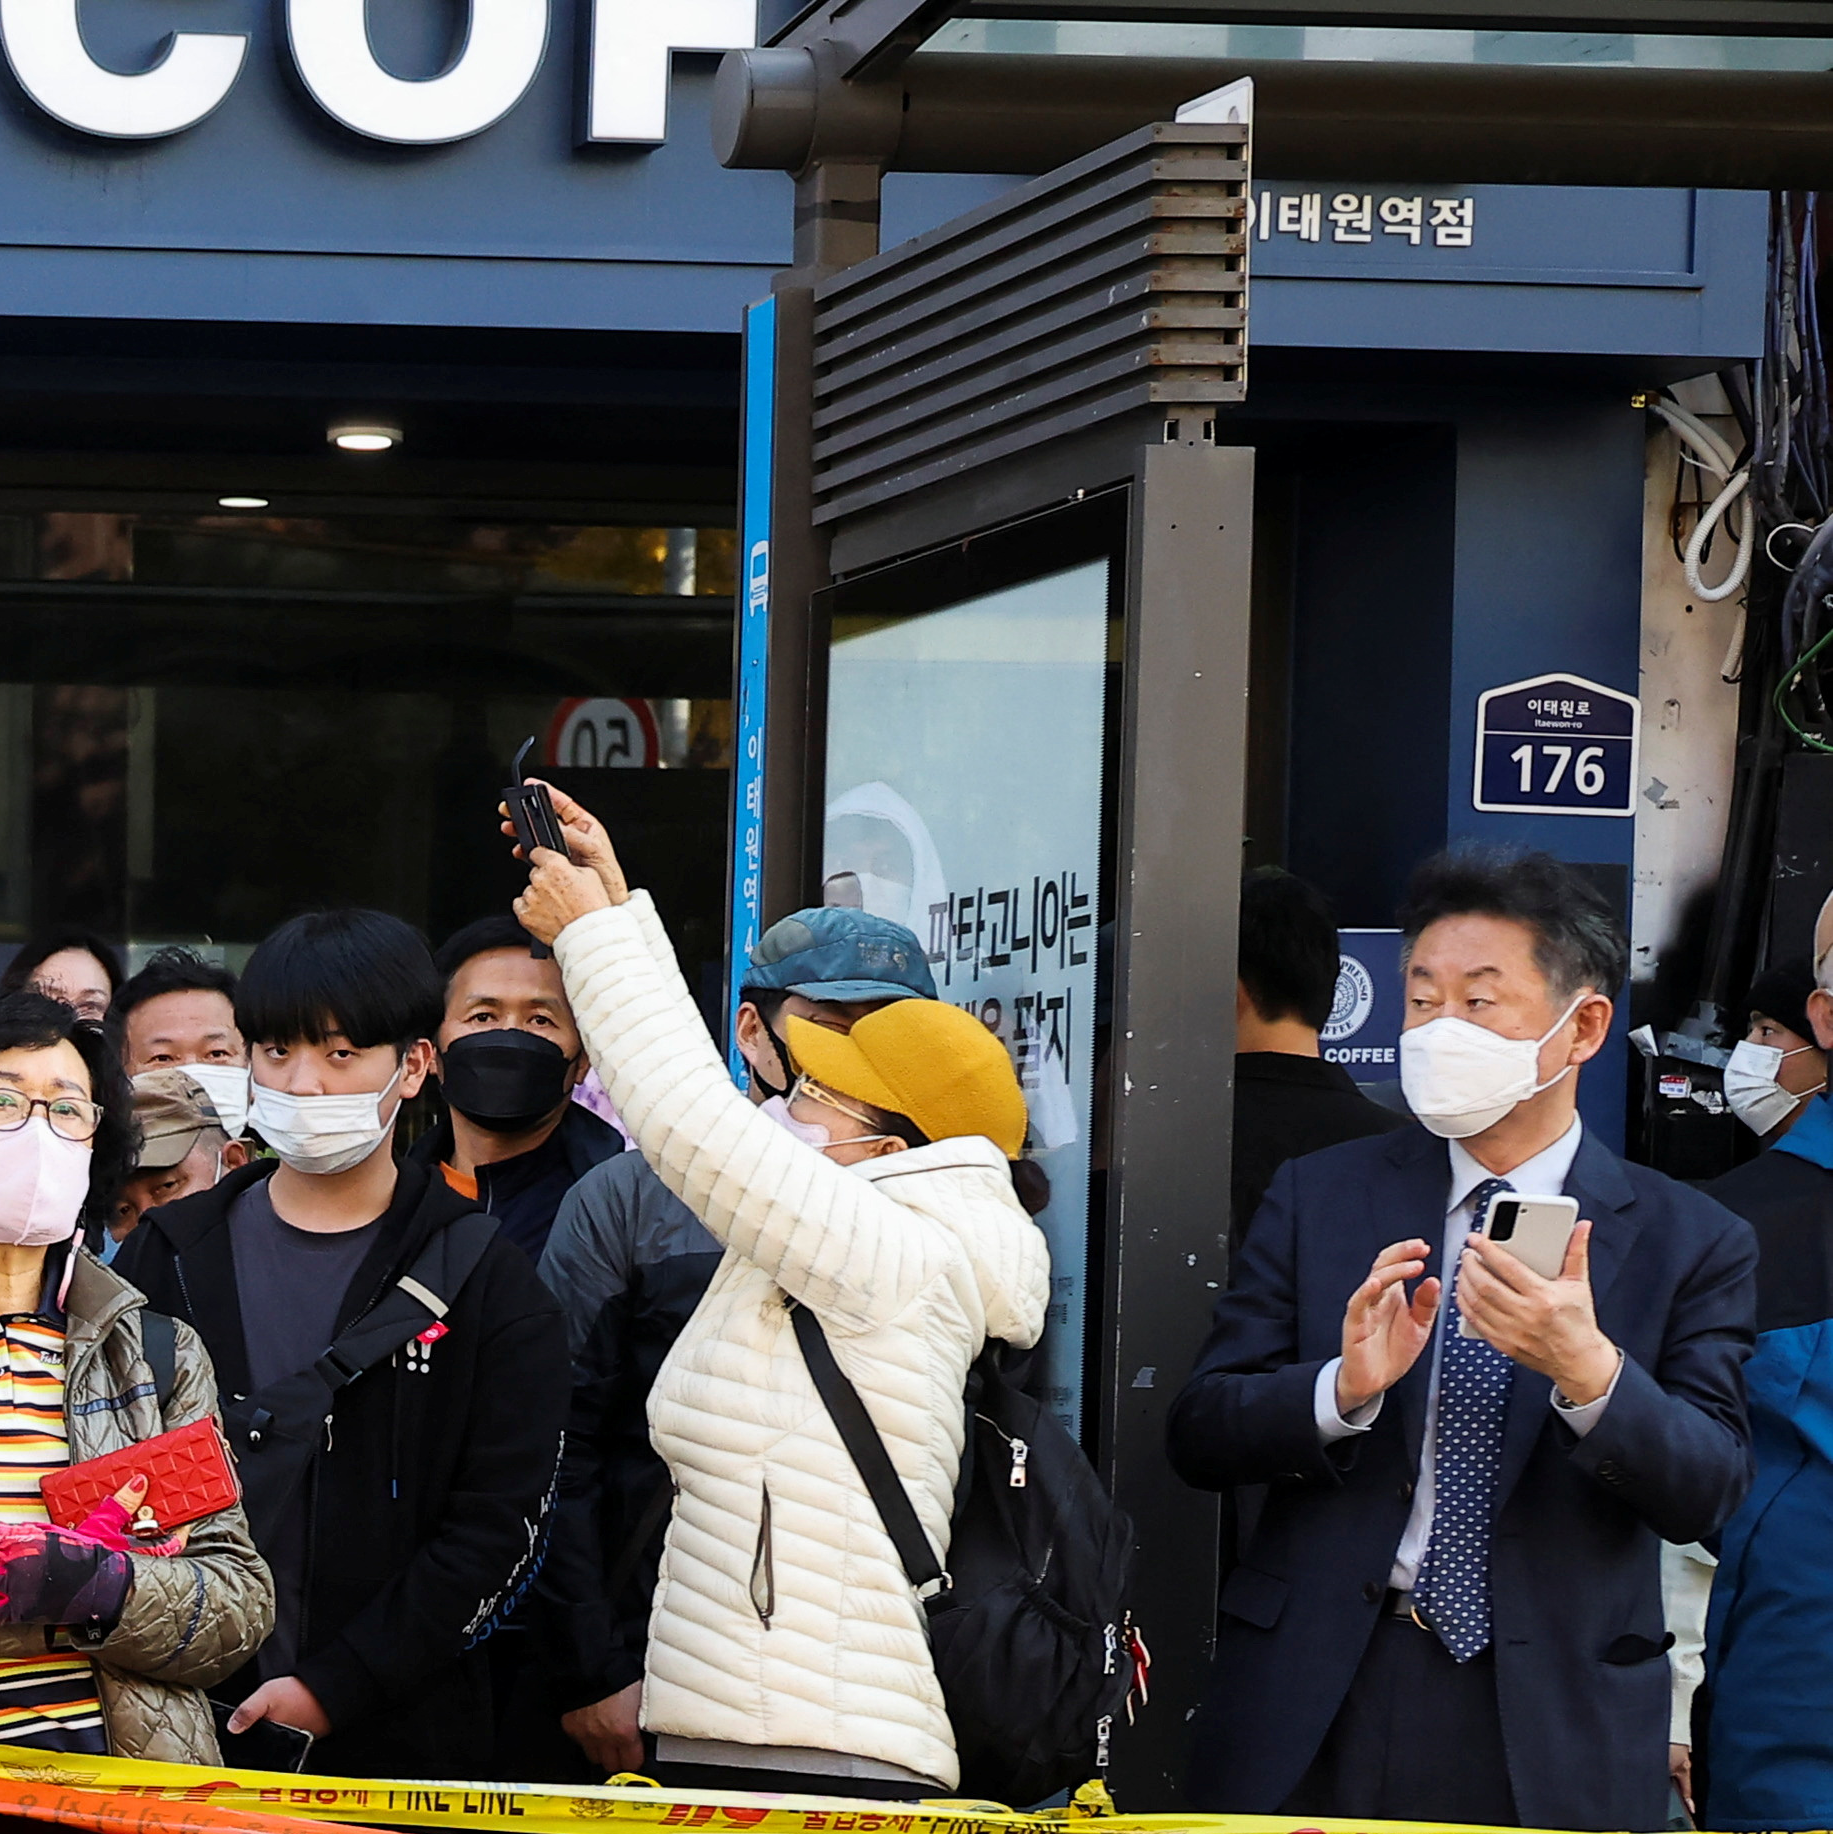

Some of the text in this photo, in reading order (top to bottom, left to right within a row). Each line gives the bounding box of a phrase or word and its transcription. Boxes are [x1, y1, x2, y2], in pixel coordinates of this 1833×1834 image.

[1247, 190, 1475, 247] 이태원역점
[1526, 698, 1591, 719] 이태원로
[1534, 718, 1583, 729] Itaewon-ro
[1510, 744, 1605, 796] 176
[926, 871, 1091, 986] 파타고니아는
[1324, 1047, 1396, 1064] COFFEE
